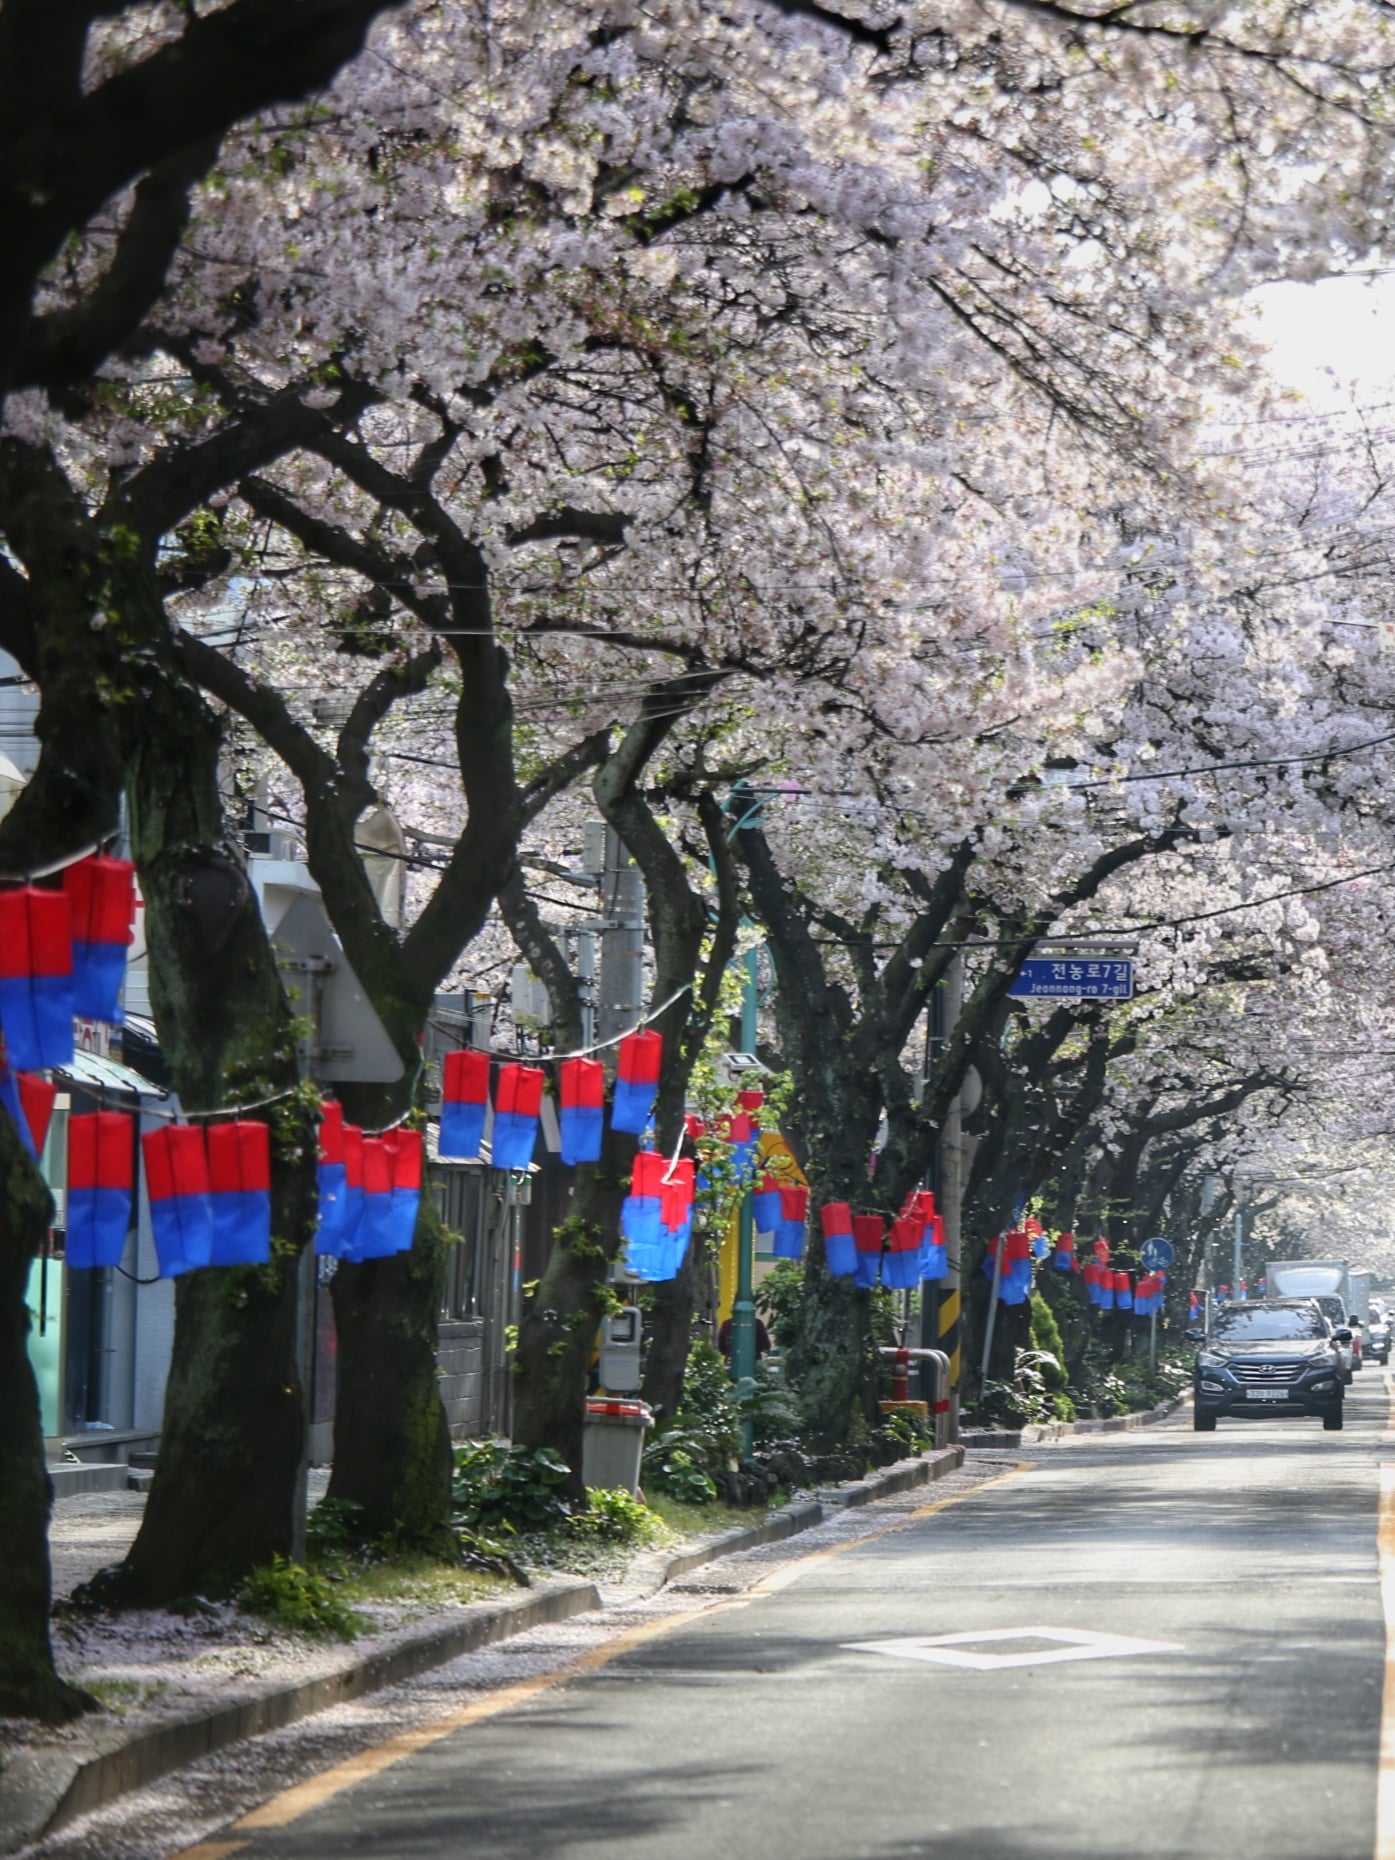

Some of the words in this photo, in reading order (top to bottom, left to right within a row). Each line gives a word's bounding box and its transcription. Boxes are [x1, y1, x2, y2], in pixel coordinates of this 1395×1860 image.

[1051, 963, 1128, 981] 전농로7길
[1029, 983, 1098, 996] Jeonnong-ro
[1101, 983, 1128, 997] 7-gil
